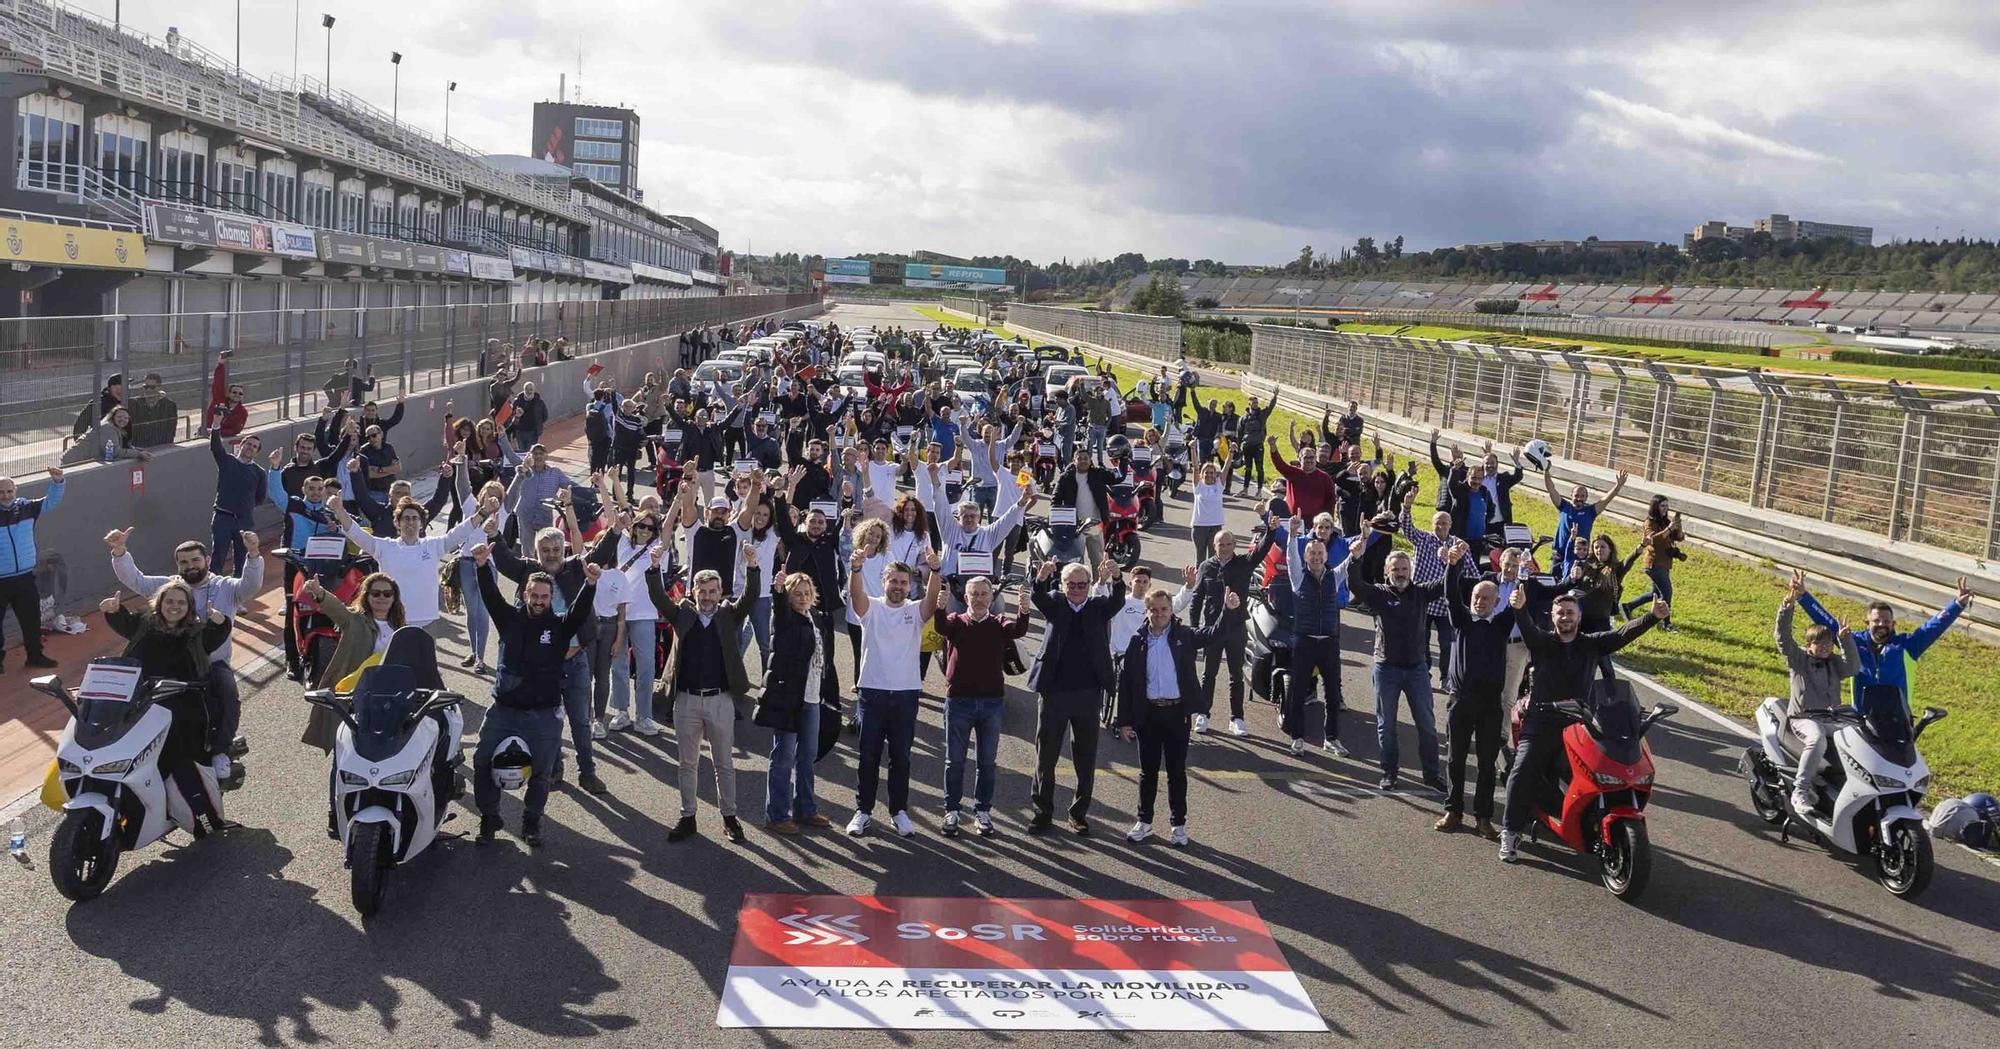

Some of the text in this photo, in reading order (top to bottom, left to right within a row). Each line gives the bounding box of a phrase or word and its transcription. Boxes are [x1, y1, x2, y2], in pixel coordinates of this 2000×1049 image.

[217, 219, 250, 246] Champs
[949, 269, 984, 279] REPSOL
[896, 923, 1047, 942] SoSR
[1072, 925, 1217, 934] Solidaridad
[1074, 933, 1238, 943] sobre ruedas
[780, 979, 1251, 991] AYUDA A RECUPERAR LA MOVILIDAD
[814, 989, 1223, 1000] A LOS AFECTADOS POR LA DANA
